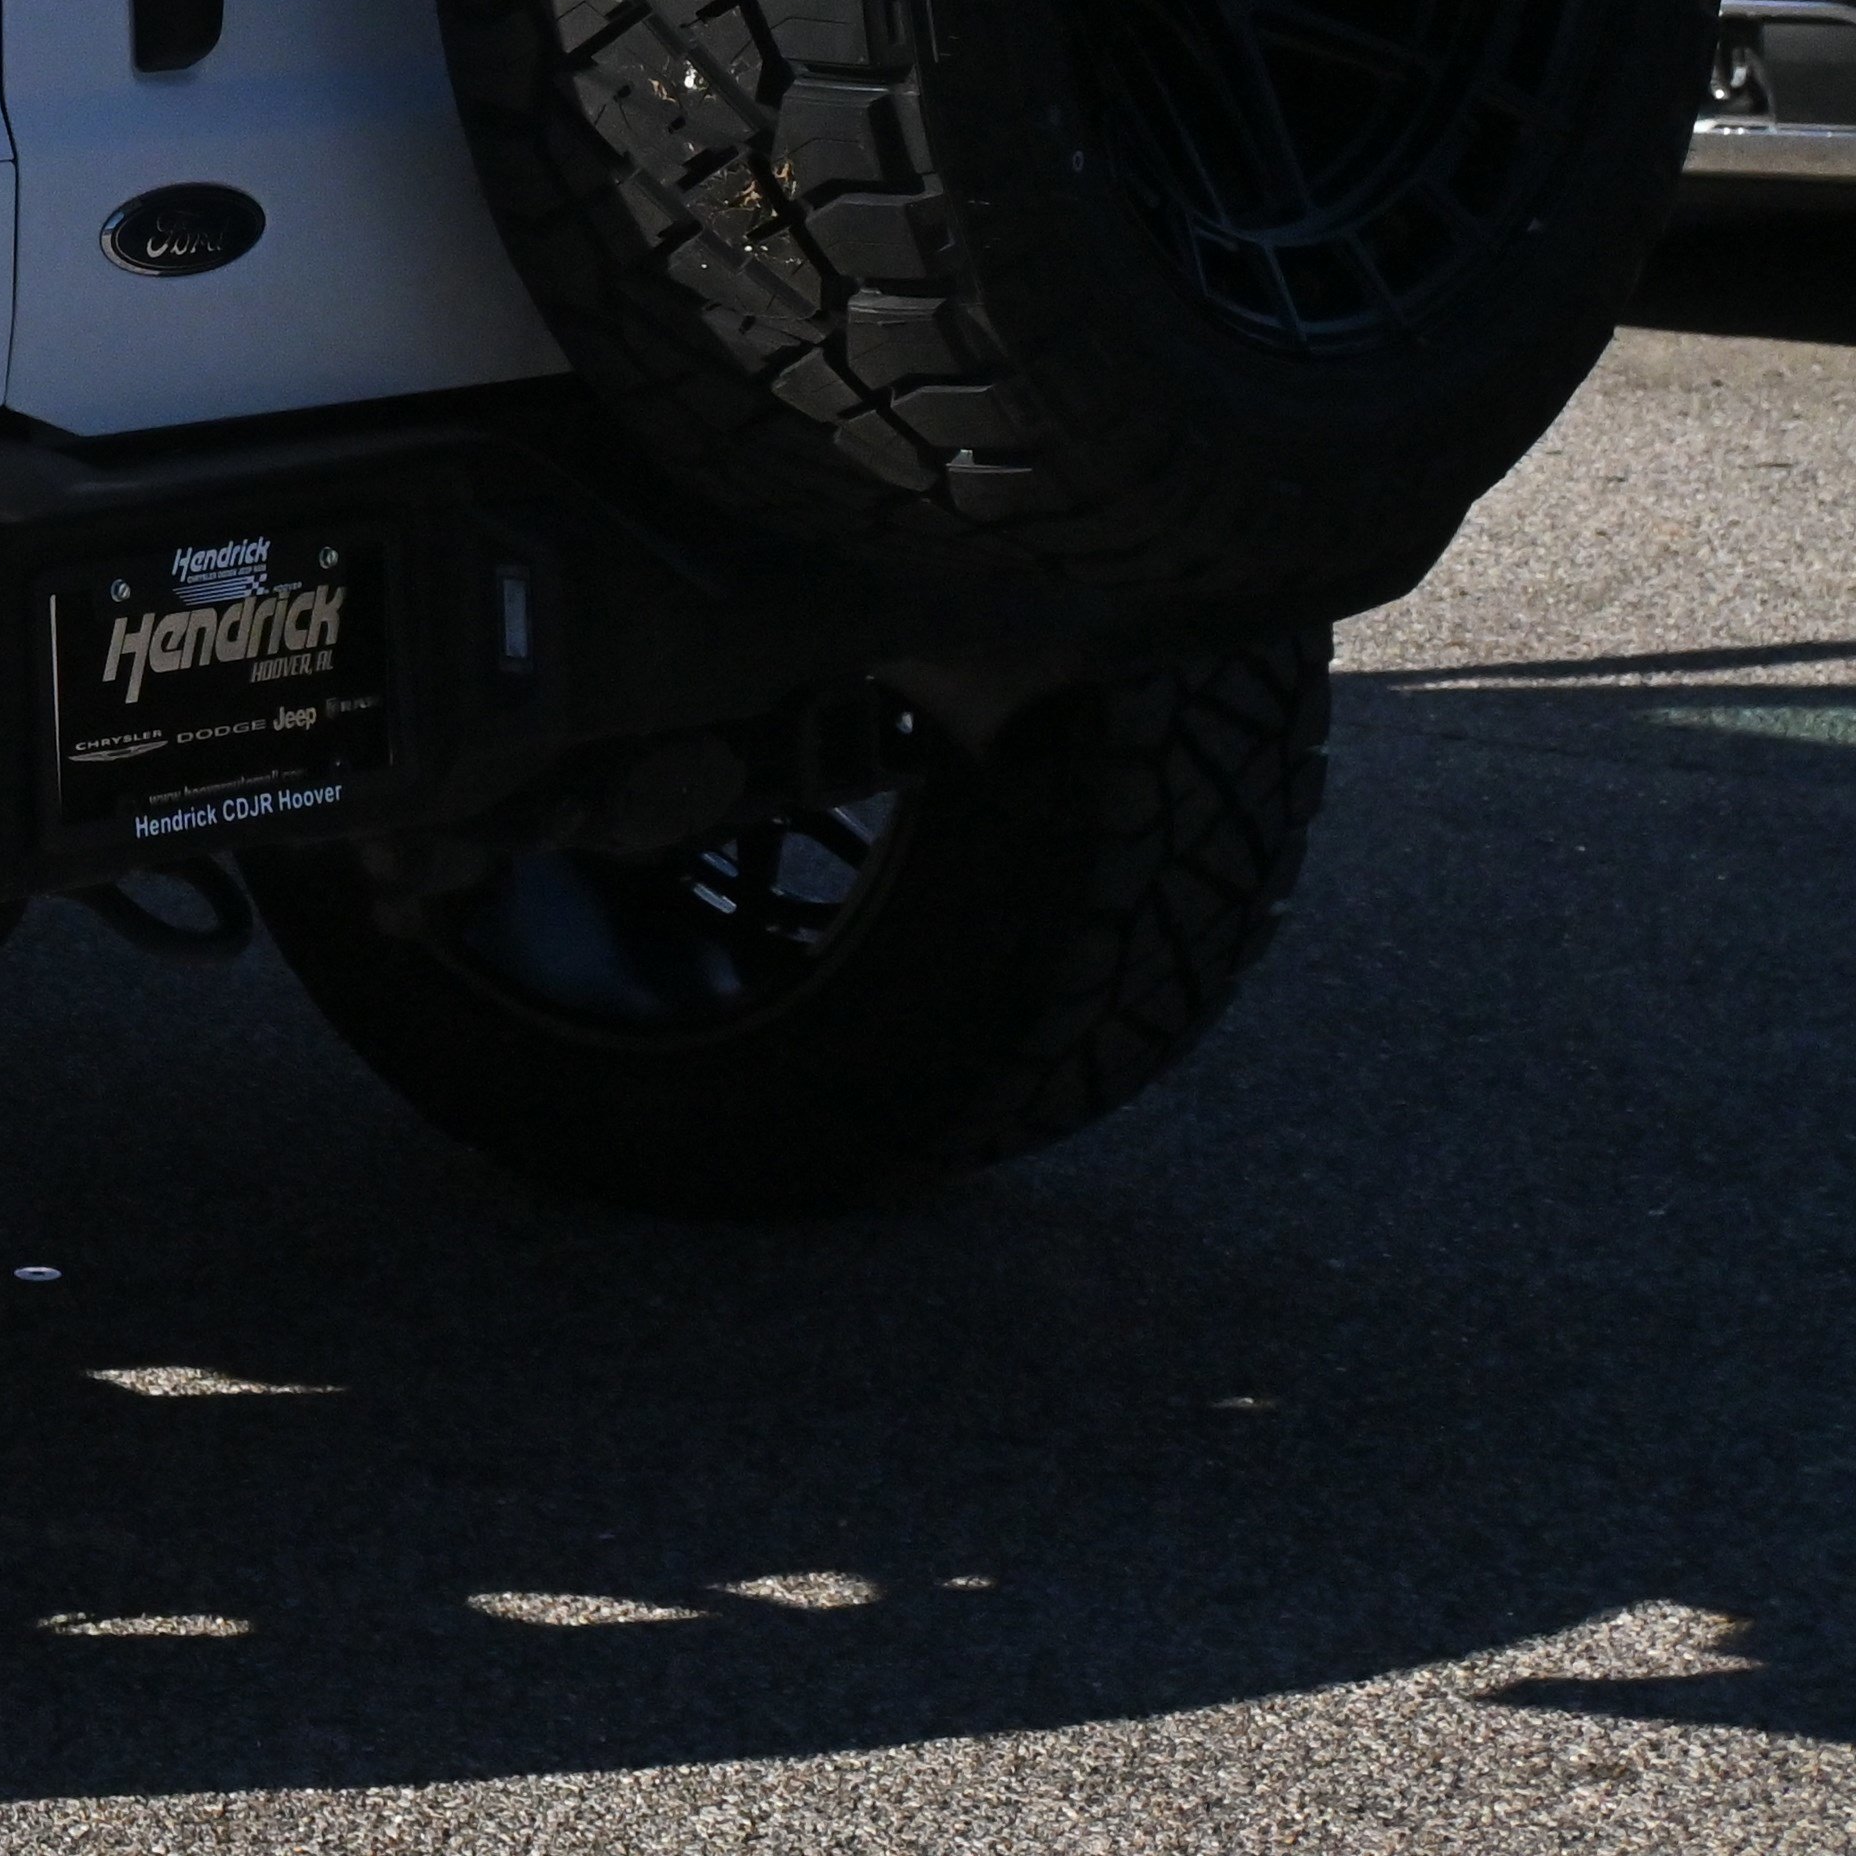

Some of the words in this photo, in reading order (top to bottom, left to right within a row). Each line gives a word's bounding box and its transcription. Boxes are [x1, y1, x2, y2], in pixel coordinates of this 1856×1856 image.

[171, 536, 271, 582] Hendrick
[102, 584, 348, 704] Hendrick
[250, 653, 312, 684] HOOVER,
[315, 650, 334, 672] AL
[75, 729, 162, 752] CHRYSLER
[176, 718, 267, 744] DODGE
[273, 705, 317, 731] Jeep
[134, 803, 218, 839] Hendrick
[222, 792, 273, 822] CDJR
[278, 784, 343, 812] Hoover
